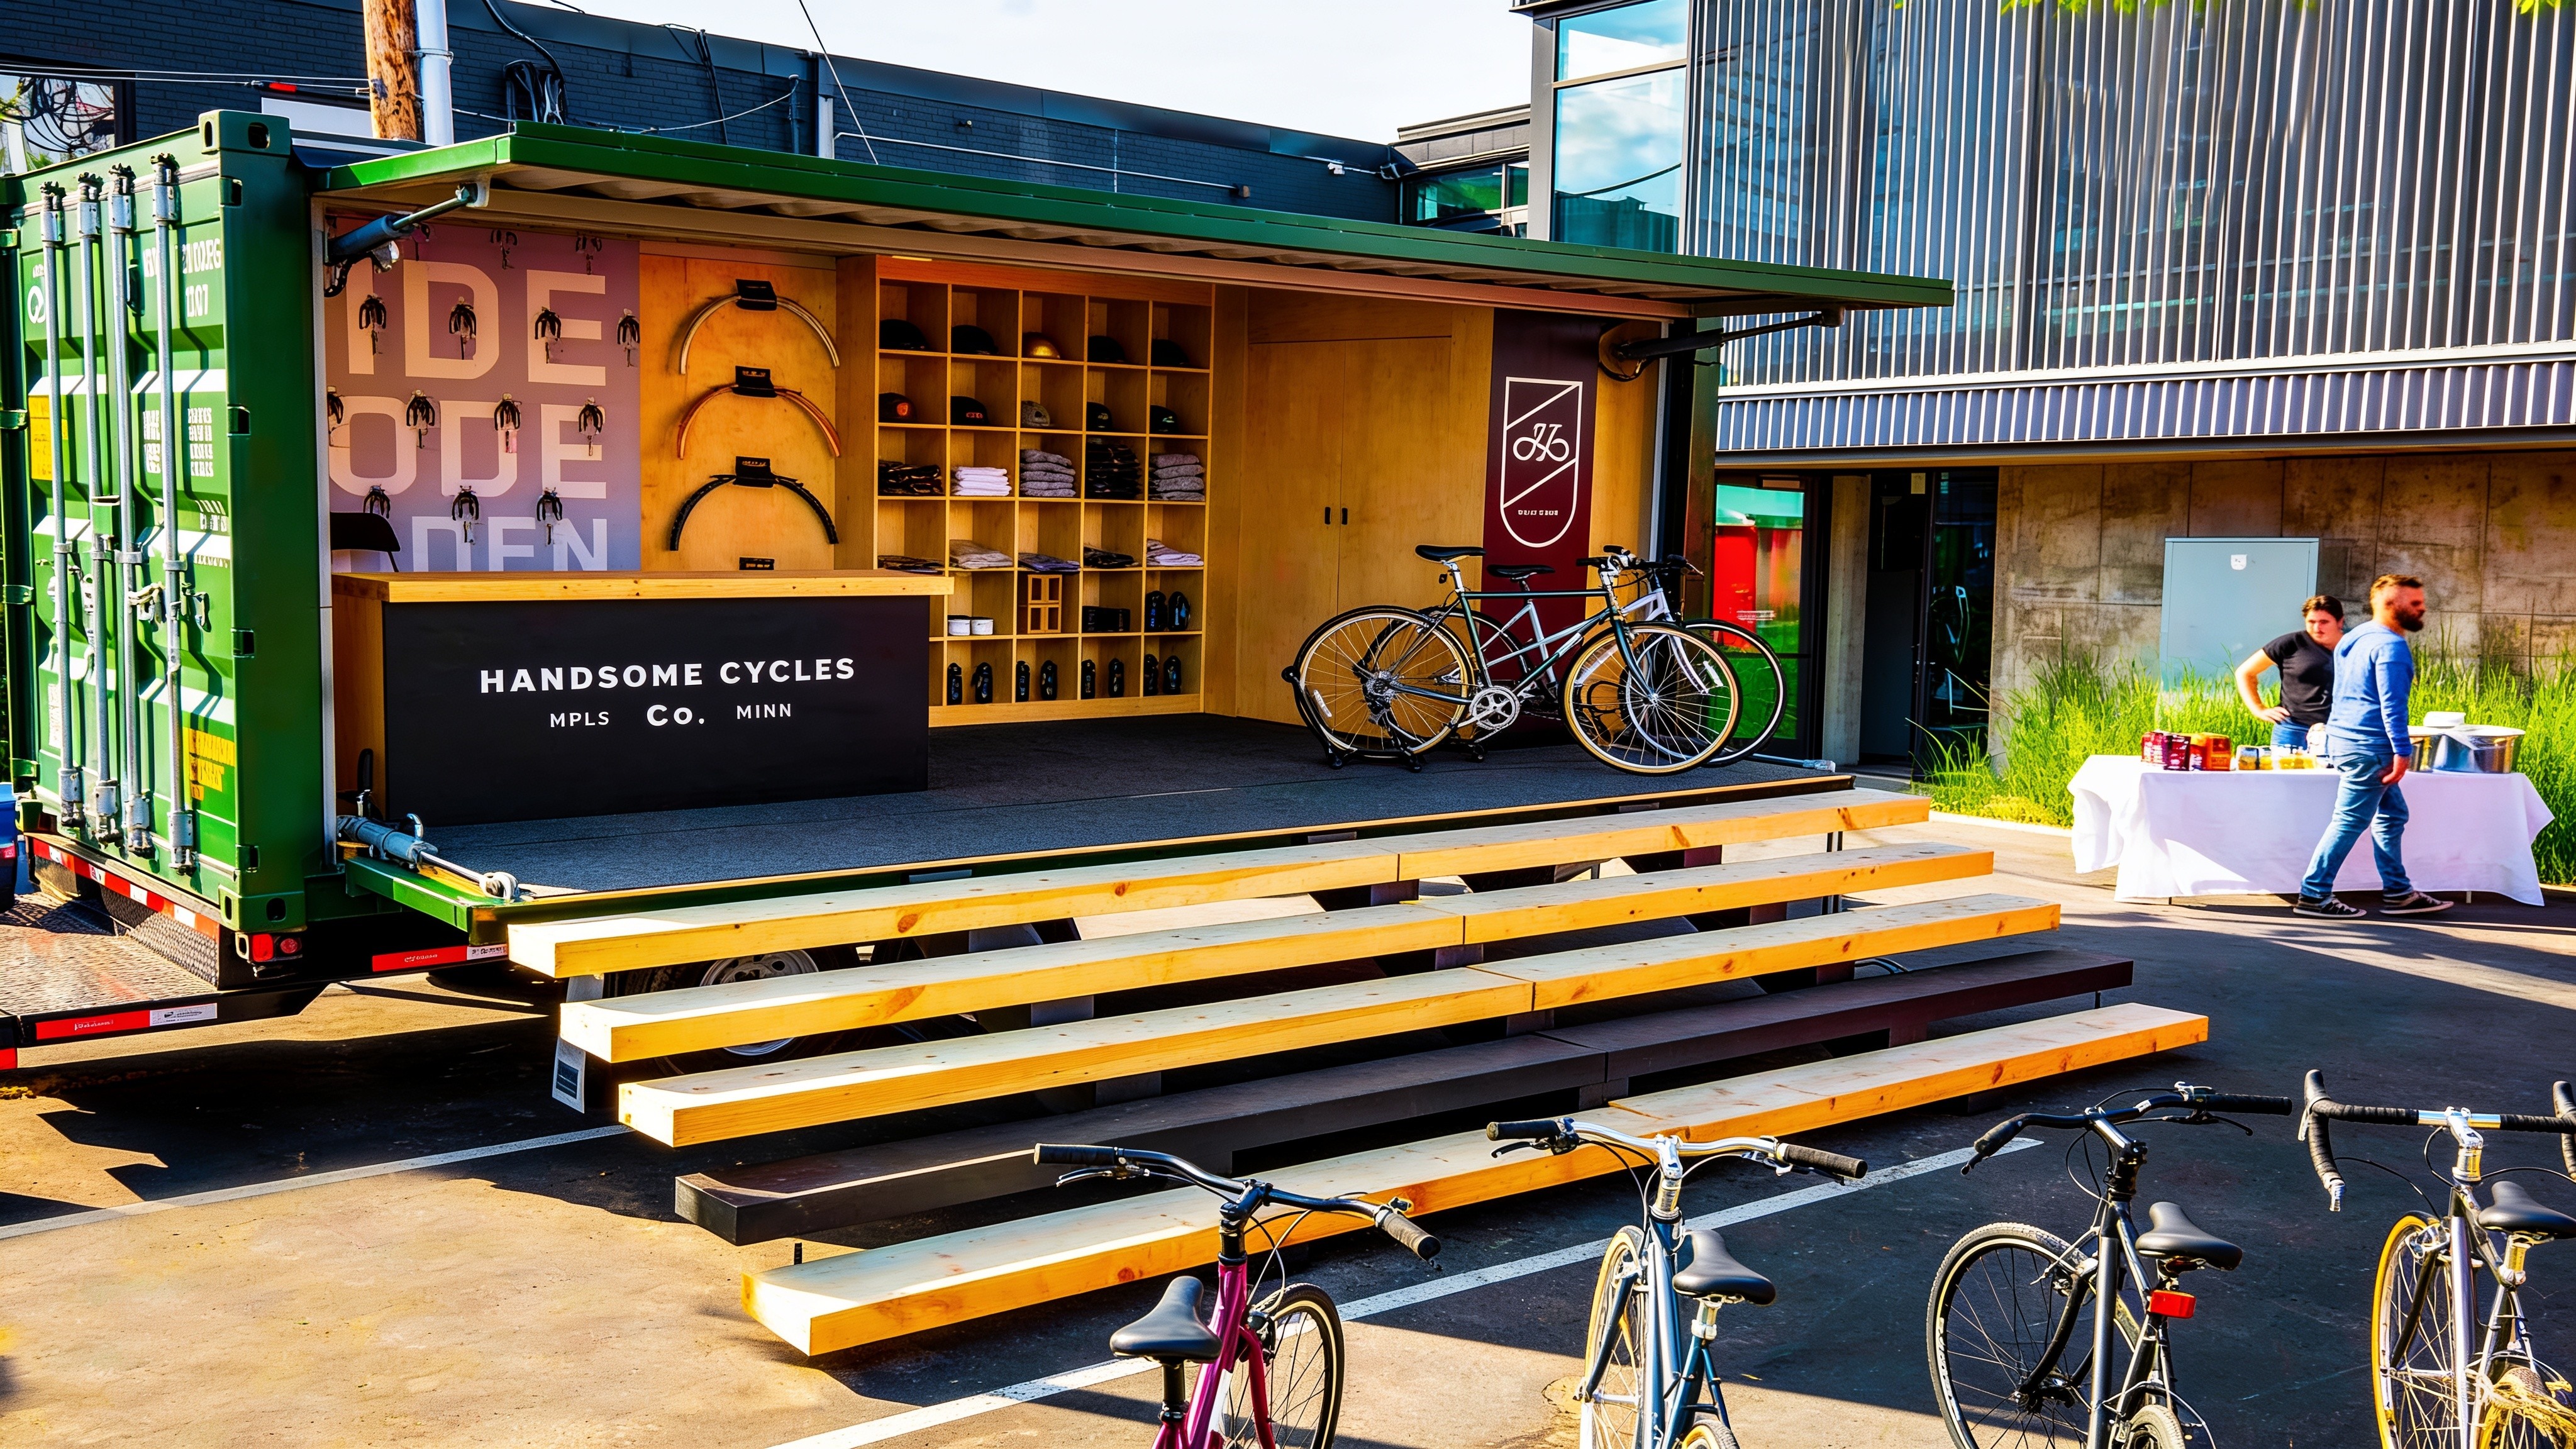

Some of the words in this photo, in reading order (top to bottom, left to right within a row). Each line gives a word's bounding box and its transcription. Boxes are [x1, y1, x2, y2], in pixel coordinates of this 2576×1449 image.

[480, 663, 703, 694] HANDSOME
[719, 657, 855, 684] CYCLES
[550, 711, 610, 728] MPLS
[647, 704, 705, 726] Co.
[736, 703, 792, 719] MINN
